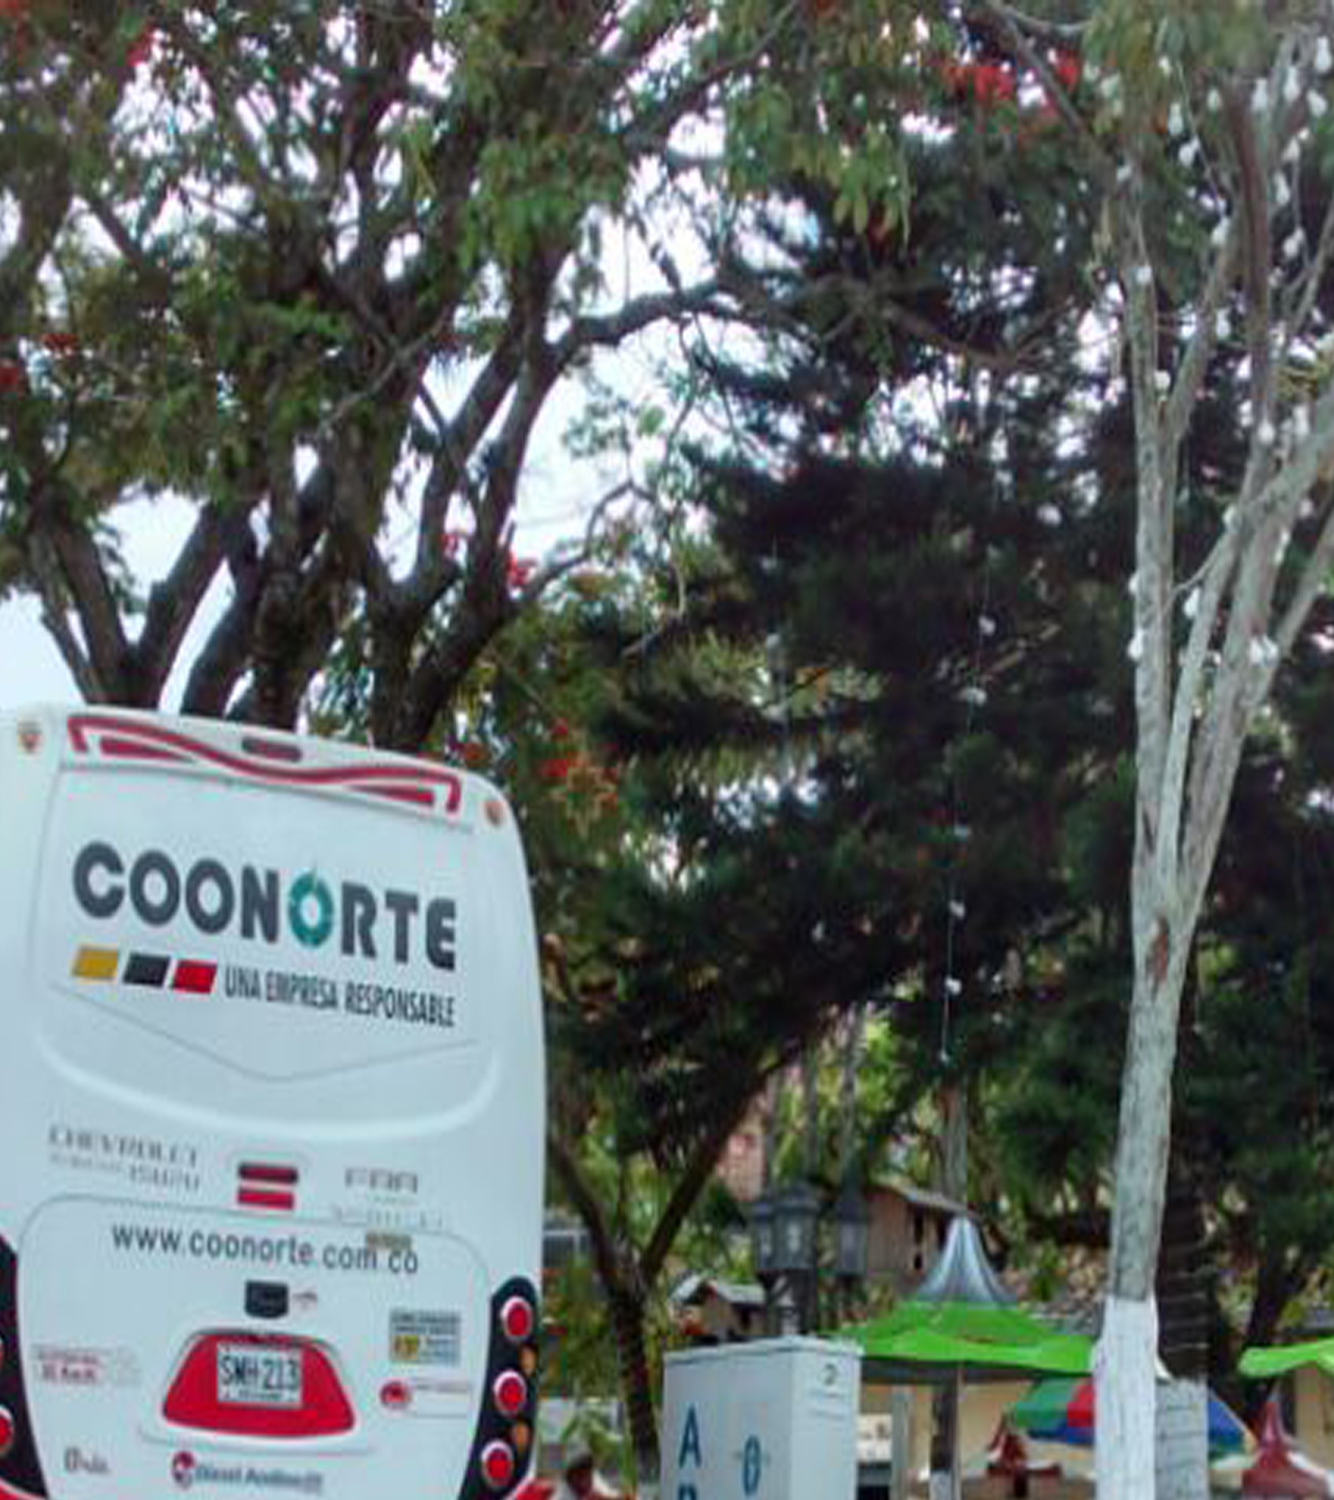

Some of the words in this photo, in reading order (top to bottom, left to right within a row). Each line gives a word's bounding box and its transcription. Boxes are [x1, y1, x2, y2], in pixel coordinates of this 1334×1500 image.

[72, 841, 457, 972] COONORTE
[224, 966, 261, 1001] UNA
[265, 970, 339, 1010] EMPRESA
[344, 982, 456, 1028] RESPONSABLE
